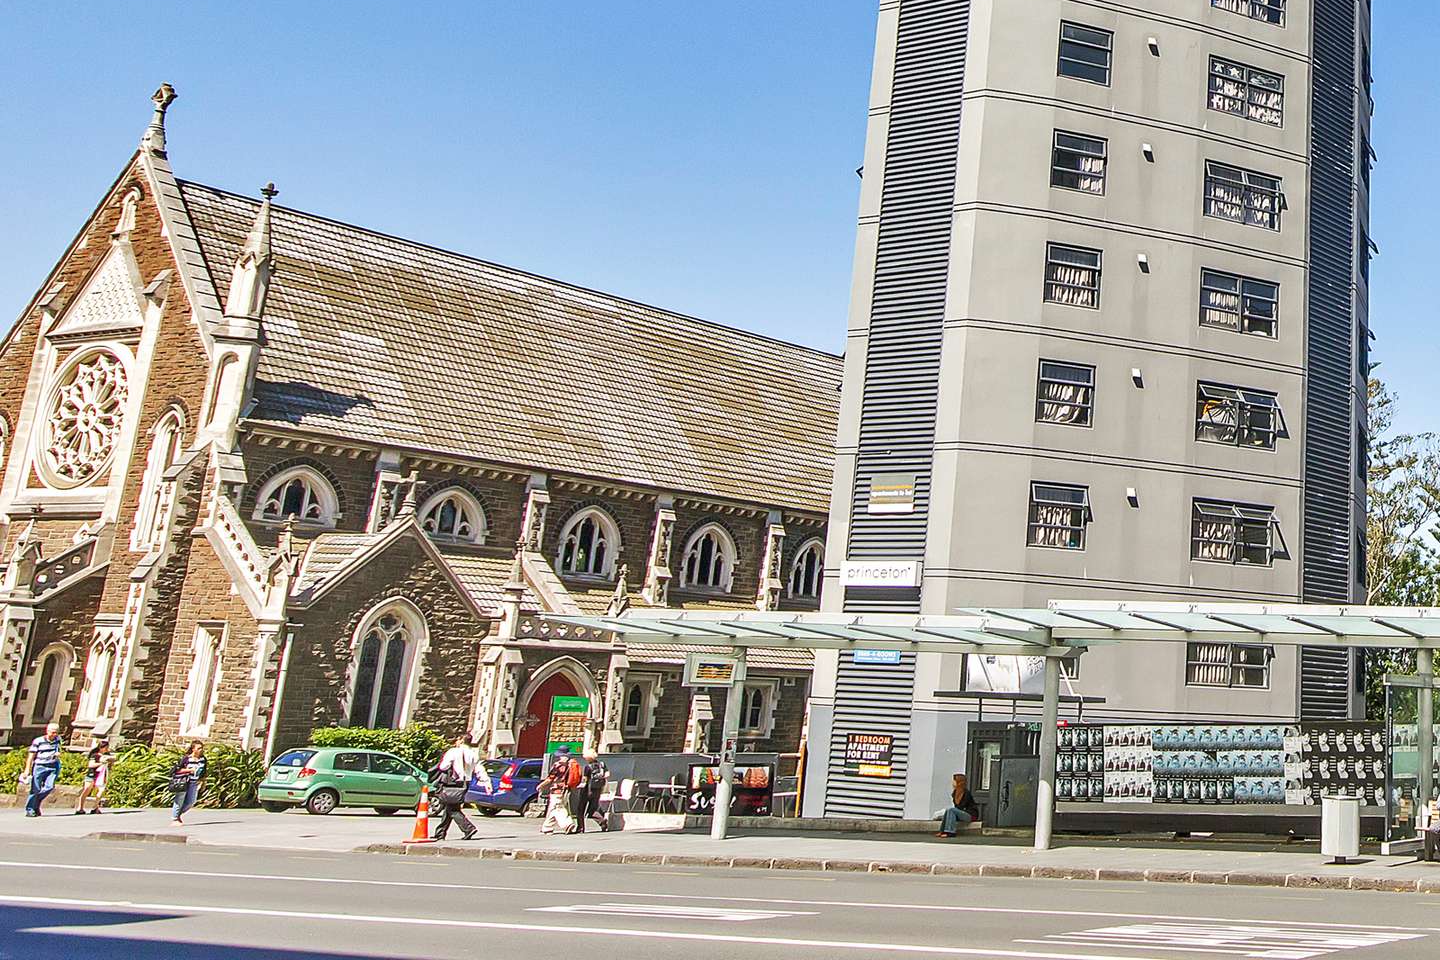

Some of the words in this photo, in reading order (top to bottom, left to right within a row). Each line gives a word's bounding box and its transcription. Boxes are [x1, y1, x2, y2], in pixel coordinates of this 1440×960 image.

[848, 566, 908, 581] princeton
[855, 735, 890, 744] BEDROOM
[848, 743, 889, 752] APARTMENT
[847, 750, 861, 758] FOR
[862, 751, 880, 760] RENT
[689, 792, 737, 809] Susi
